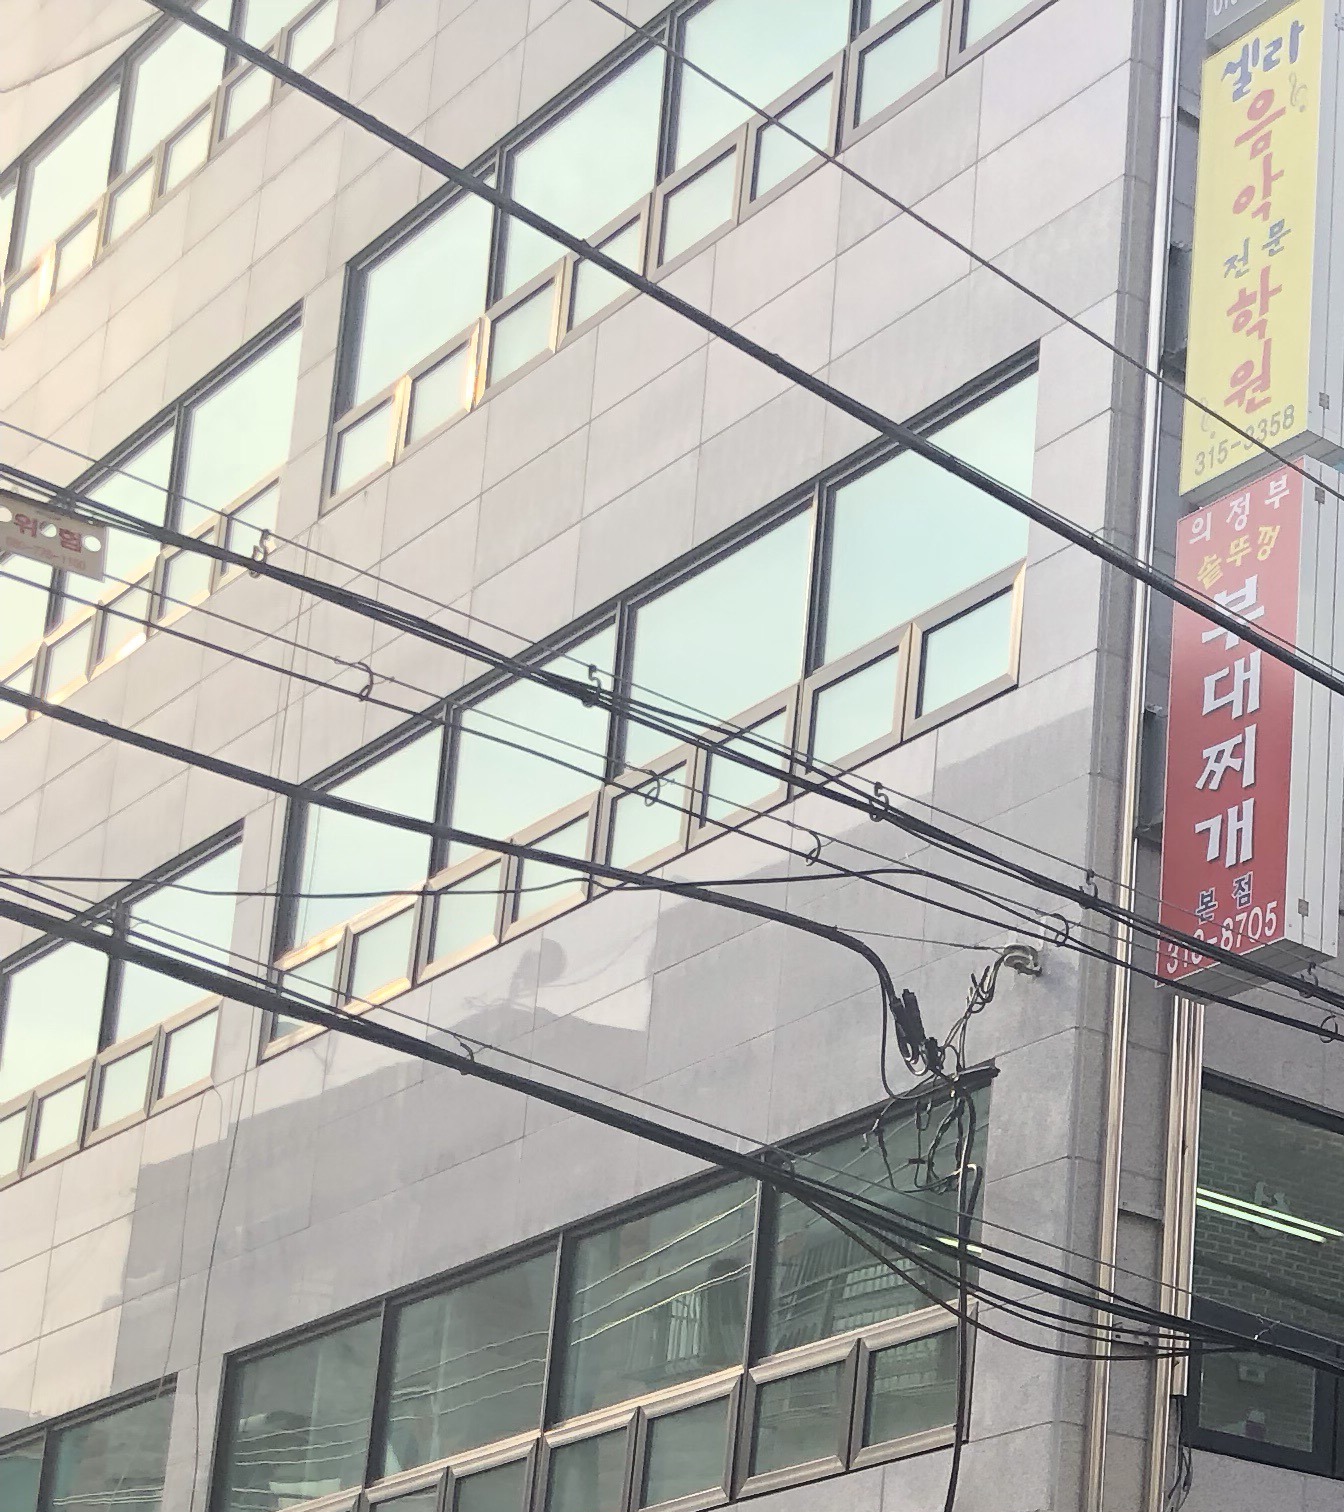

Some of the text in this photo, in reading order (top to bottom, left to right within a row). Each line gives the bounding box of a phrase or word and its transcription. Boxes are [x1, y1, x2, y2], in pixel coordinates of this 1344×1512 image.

[1223, 218, 1293, 280] 전문
[1194, 404, 1296, 477] 315-3358
[1188, 474, 1290, 544] 의정부
[1196, 524, 1281, 588] 솥뚜껑
[1193, 575, 1266, 868] 부대찌개
[1195, 870, 1254, 925] 본점
